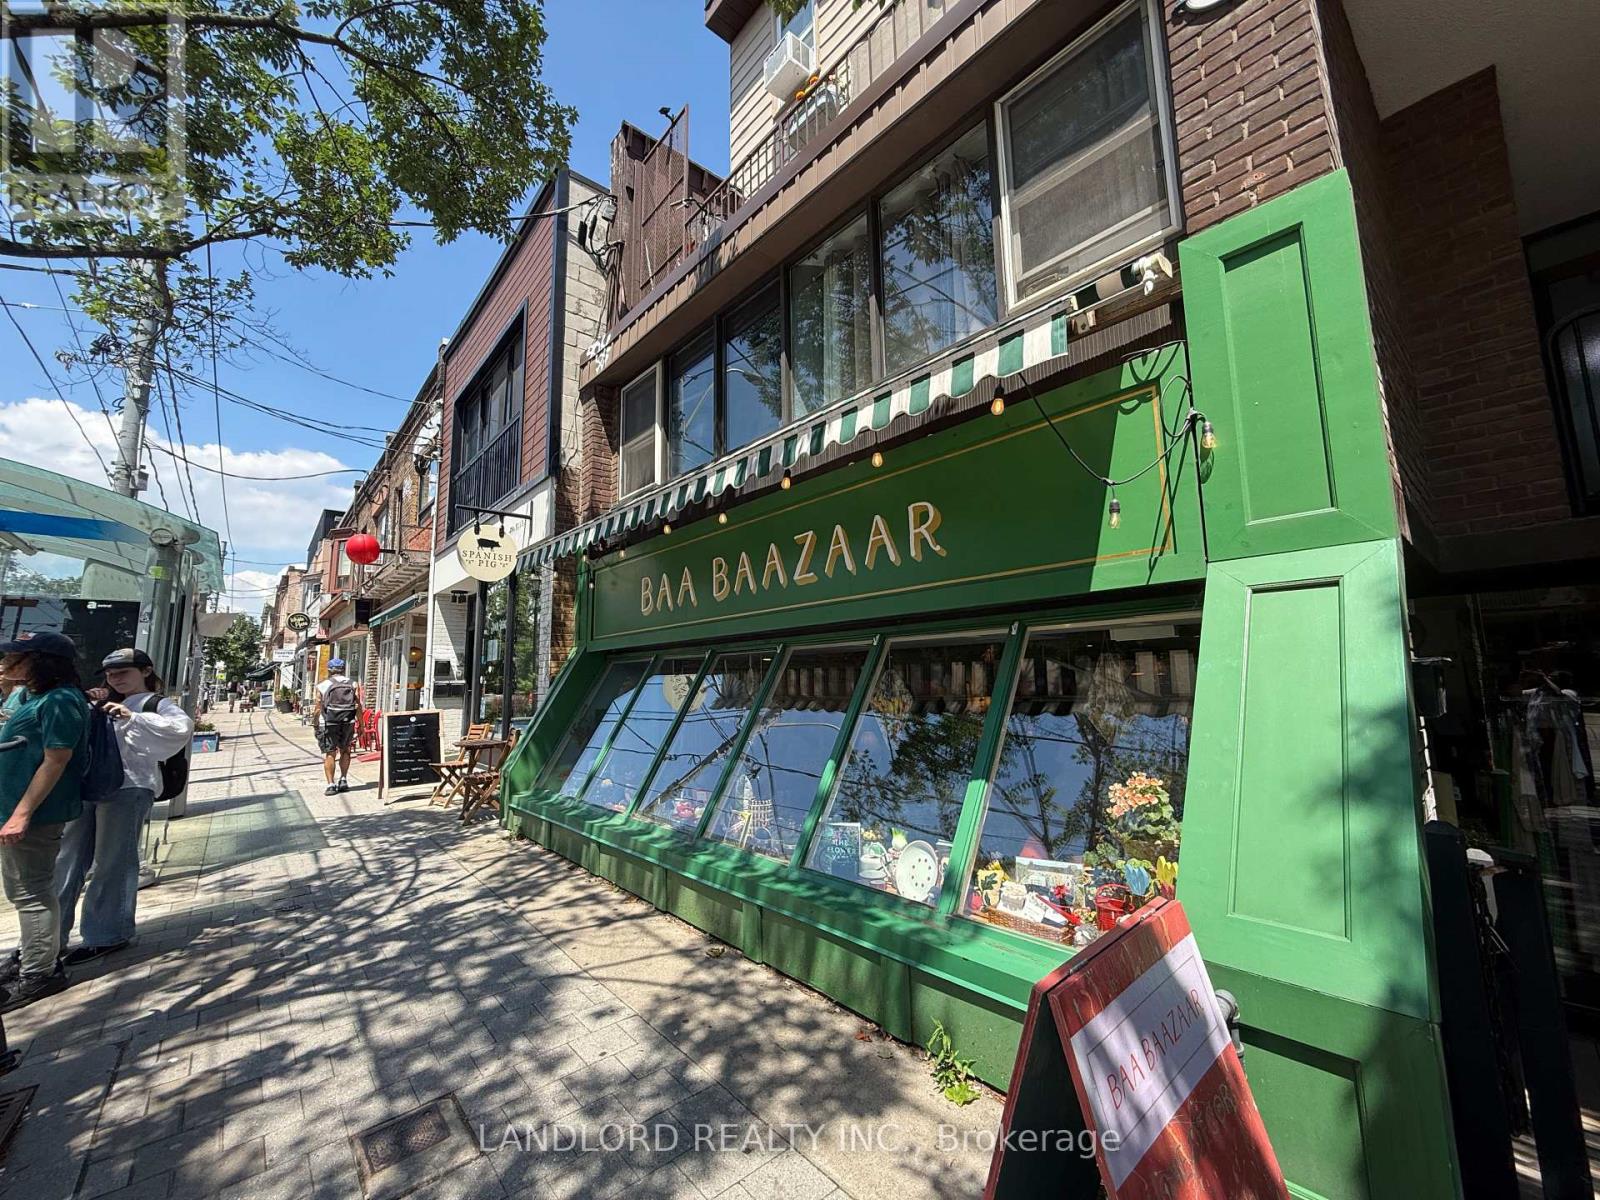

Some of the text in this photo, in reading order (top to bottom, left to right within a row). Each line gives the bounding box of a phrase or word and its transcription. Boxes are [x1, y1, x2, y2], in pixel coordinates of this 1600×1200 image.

[462, 550, 512, 562] SPANISH
[478, 560, 497, 568] PIG
[640, 501, 947, 617] BAA BAAZAAR
[1106, 988, 1204, 1110] BAA BAAZAAR
